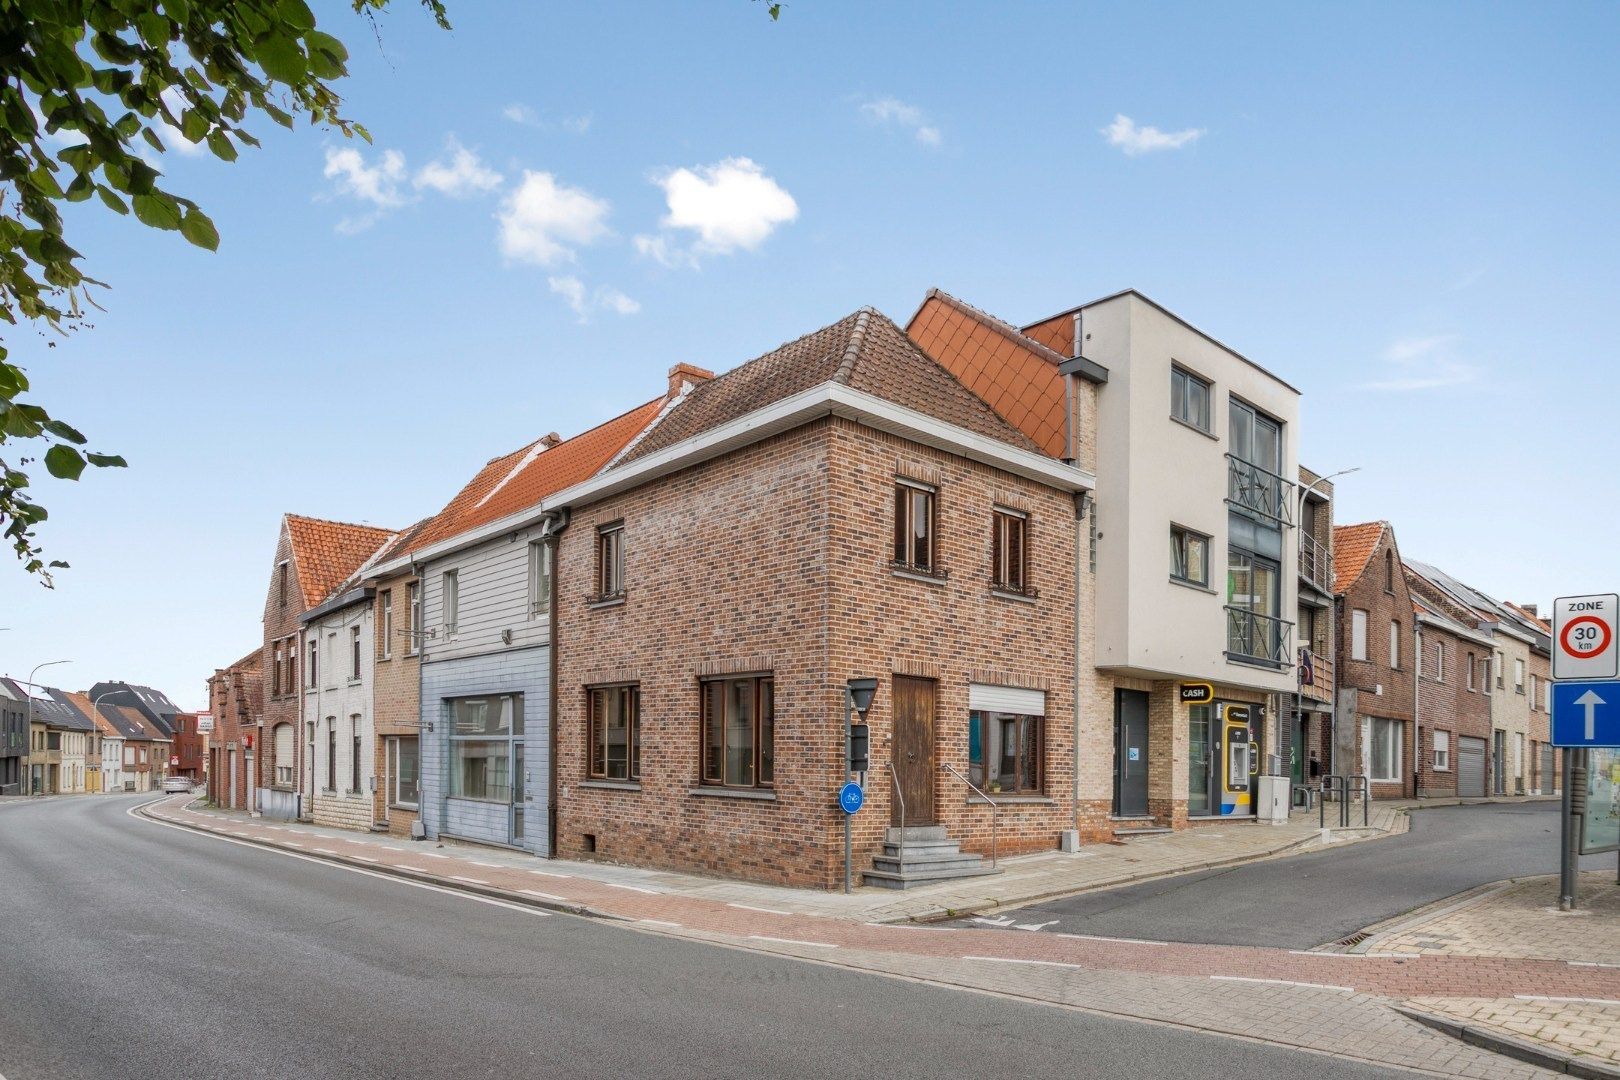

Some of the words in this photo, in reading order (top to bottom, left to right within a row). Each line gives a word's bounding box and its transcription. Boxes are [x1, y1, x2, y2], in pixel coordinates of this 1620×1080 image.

[1568, 601, 1603, 611] ZONE
[1574, 627, 1597, 640] 30
[1578, 642, 1592, 650] km
[1182, 689, 1204, 697] CASH
